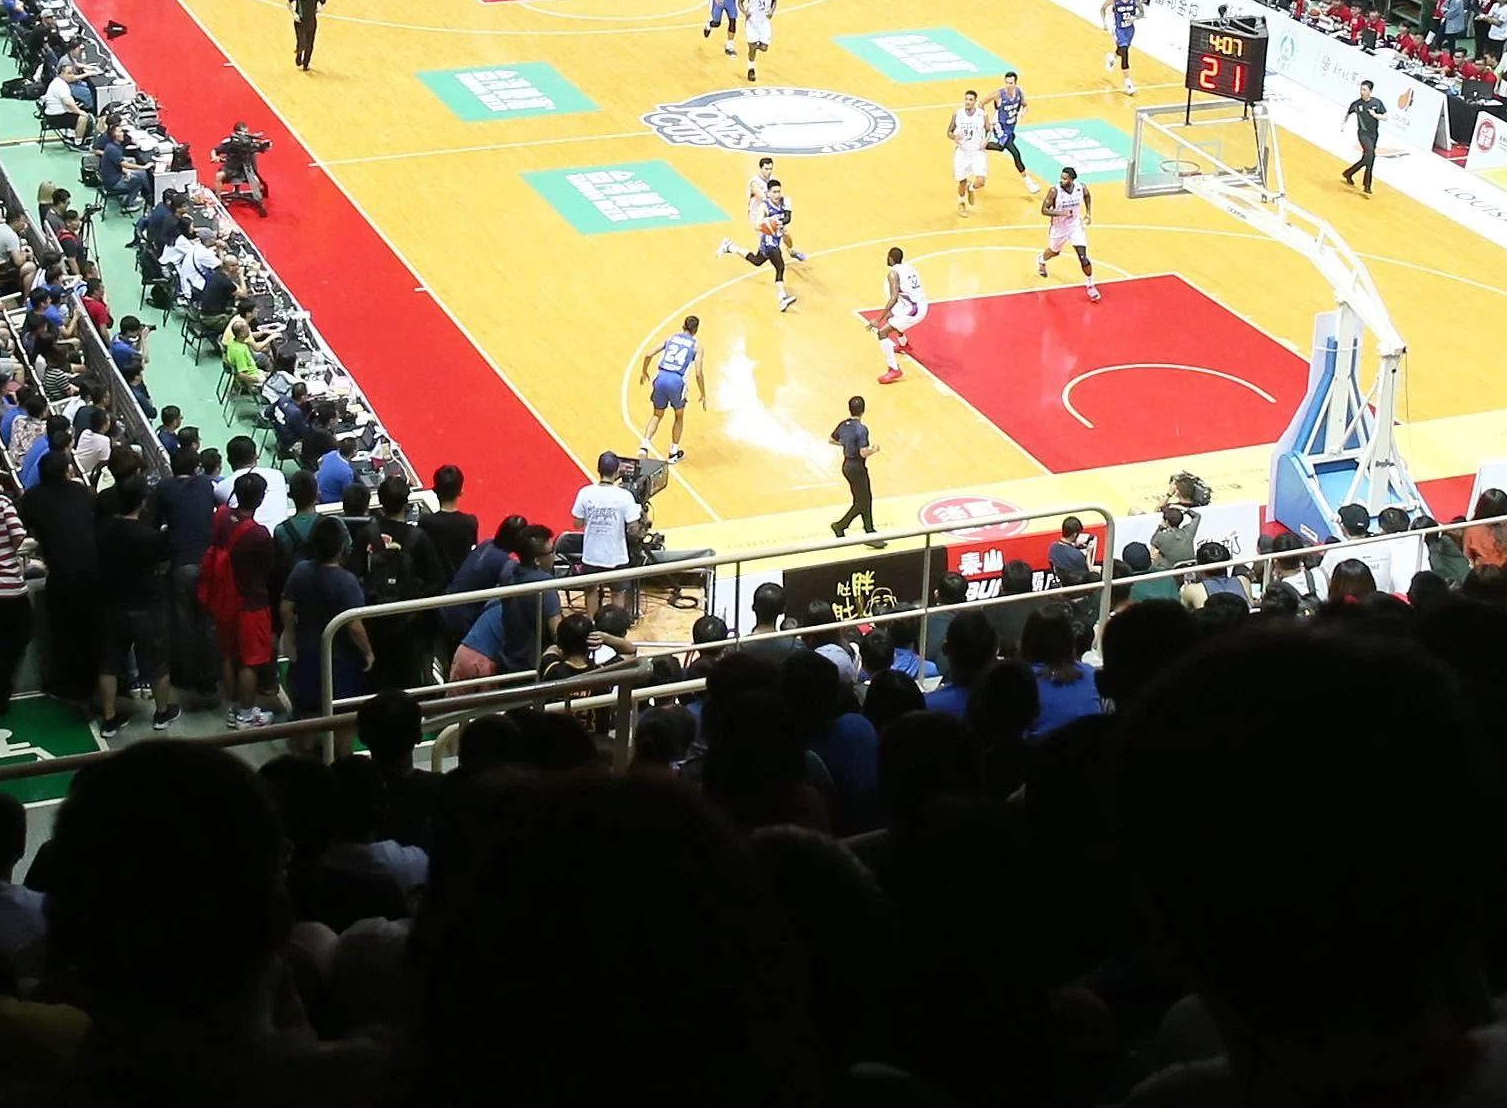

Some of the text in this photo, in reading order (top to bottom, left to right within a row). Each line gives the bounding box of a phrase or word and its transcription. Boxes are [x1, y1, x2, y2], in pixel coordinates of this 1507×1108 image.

[1208, 32, 1243, 57] 4:07
[1199, 56, 1241, 94] 21
[664, 344, 689, 366] 24
[958, 548, 1004, 577] 泰山
